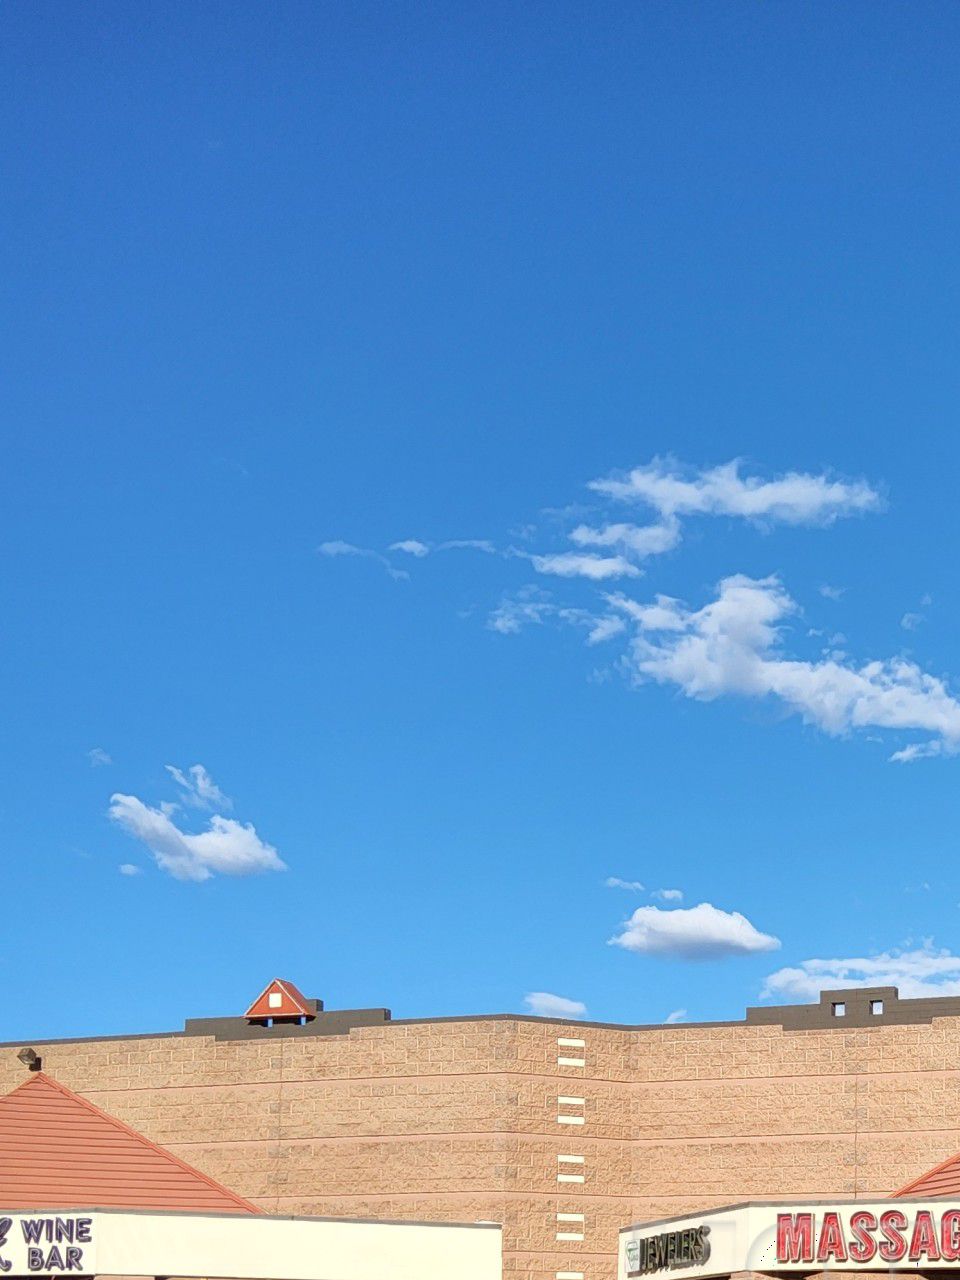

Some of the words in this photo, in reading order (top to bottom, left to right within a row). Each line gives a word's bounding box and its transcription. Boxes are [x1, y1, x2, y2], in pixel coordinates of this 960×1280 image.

[20, 1217, 93, 1245] WINE
[28, 1245, 83, 1271] BAR
[640, 1226, 711, 1275] JEWELERS
